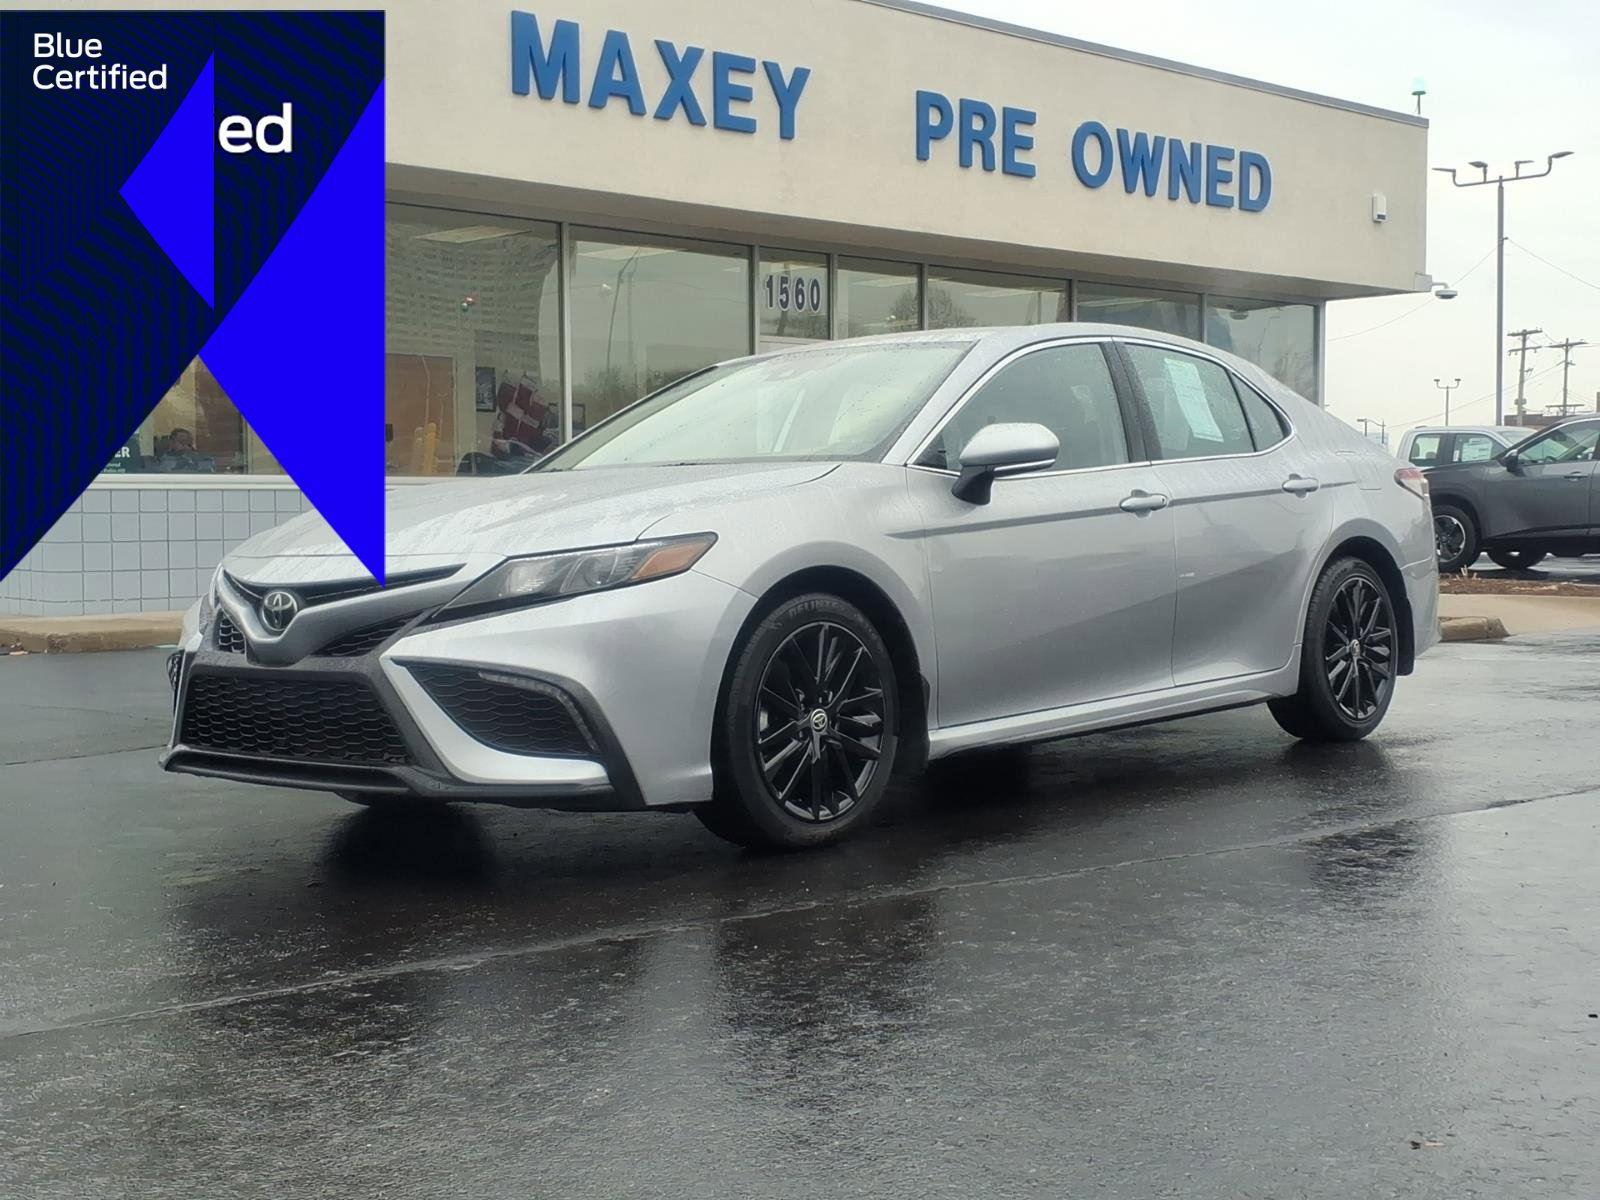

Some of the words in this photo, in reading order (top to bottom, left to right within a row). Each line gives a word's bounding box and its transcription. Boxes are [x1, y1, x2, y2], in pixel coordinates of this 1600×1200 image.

[511, 11, 810, 139] MAXEY
[916, 90, 1037, 177] PRE
[1072, 121, 1272, 211] OWNED
[765, 274, 821, 312] 1560
